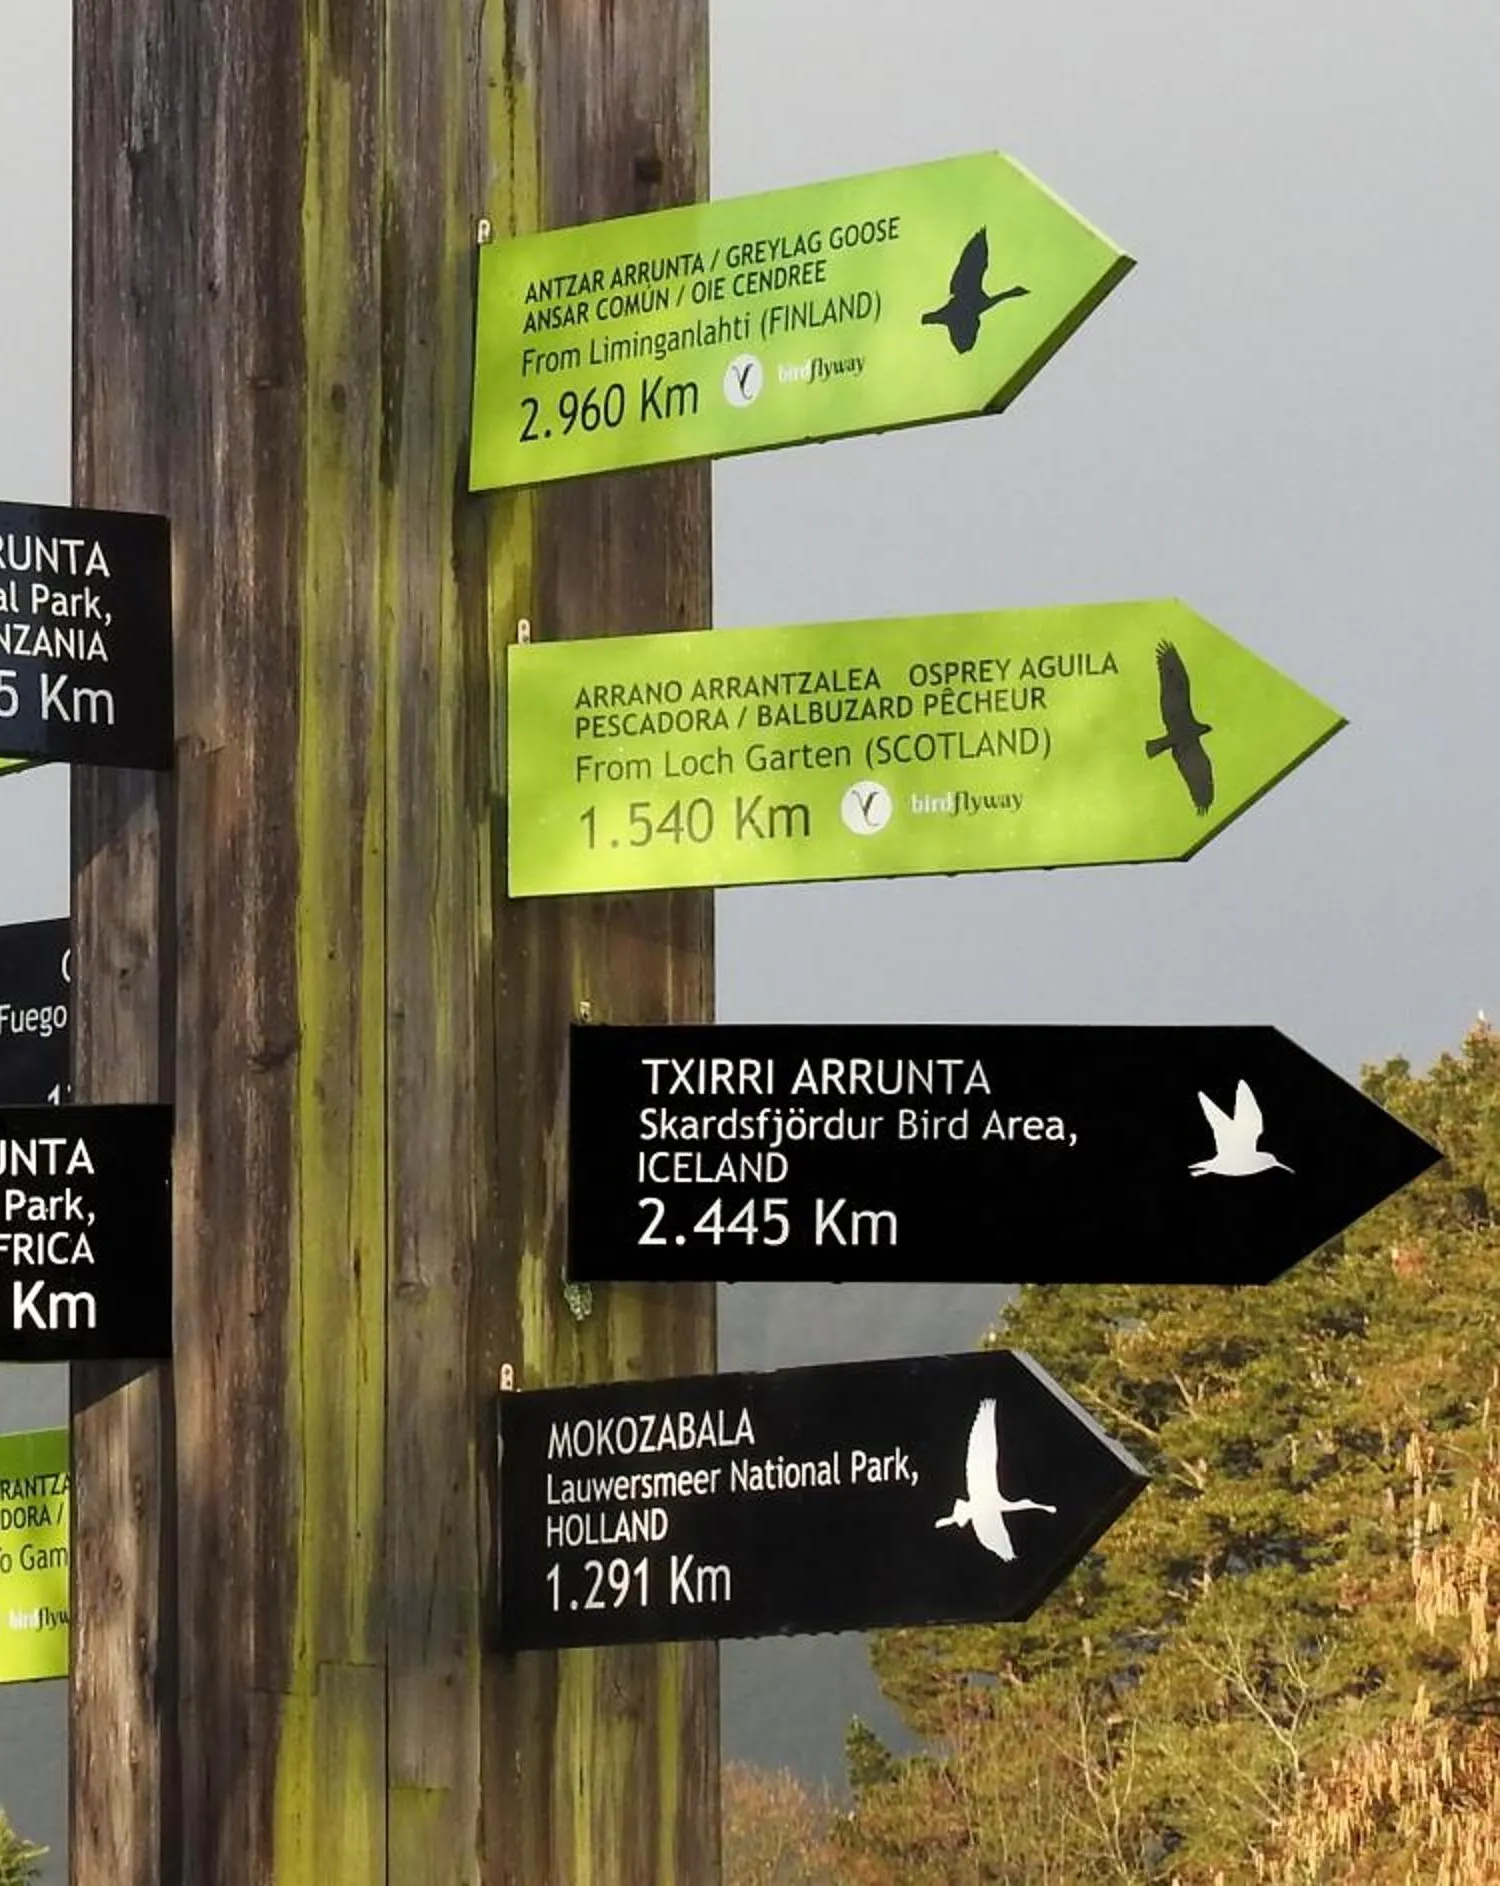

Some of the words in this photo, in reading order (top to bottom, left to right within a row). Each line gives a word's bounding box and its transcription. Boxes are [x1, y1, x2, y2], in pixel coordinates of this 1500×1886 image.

[525, 269, 605, 304] ANTZAR
[610, 251, 704, 291] ARRUNTA
[710, 248, 720, 272] /
[726, 231, 822, 268] GREYLAG
[829, 216, 901, 250] GOOSE
[523, 302, 589, 334] ANSAR
[596, 283, 669, 321] COMÚN
[676, 284, 685, 307] /
[692, 277, 726, 304] OIE
[733, 259, 827, 297] CENDREE
[521, 343, 581, 377] From
[589, 310, 751, 367] Liminganlahti
[759, 290, 882, 340] (FINLAND)
[778, 356, 865, 384] birdflyway
[519, 382, 626, 443] 2.960
[640, 376, 699, 420] Km
[31, 583, 112, 626] Park,
[40, 672, 115, 726] Km
[575, 679, 683, 710] ARRANO
[691, 666, 882, 703] ARRANTZALEA
[909, 659, 1011, 687] OSPREY
[1019, 652, 1119, 680] AGUILA
[575, 707, 729, 739] PESCADORA
[737, 705, 749, 731] /
[758, 695, 913, 729] BALBUZARD
[924, 687, 1047, 717] PÊCHEUR
[575, 753, 652, 783] From
[665, 746, 733, 779] Loch
[746, 740, 851, 774] Garten
[866, 726, 1051, 770] (SCOTLAND)
[579, 798, 714, 849] 1.540
[735, 796, 811, 839] Km
[910, 790, 1023, 817] birdflyway
[642, 1058, 775, 1096] TXIRRI
[791, 1058, 992, 1096] ARRUNTA
[639, 1107, 884, 1148] Skardsfjördur
[899, 1108, 969, 1141] Bird
[982, 1109, 1078, 1147] Area,
[637, 1151, 789, 1183] ICELAND
[4, 1188, 96, 1227] Park,
[636, 1196, 791, 1247] 2.445
[815, 1197, 898, 1246] Km
[13, 1280, 97, 1330] Km
[547, 1406, 756, 1461] MOKOZABALA
[546, 1465, 721, 1506] Lauwersmeer
[729, 1451, 842, 1492] National
[850, 1446, 919, 1488] Park,
[56, 1503, 64, 1524] /
[546, 1508, 668, 1548] HOLLAND
[545, 1557, 650, 1612] 1.291
[669, 1554, 731, 1603] Km
